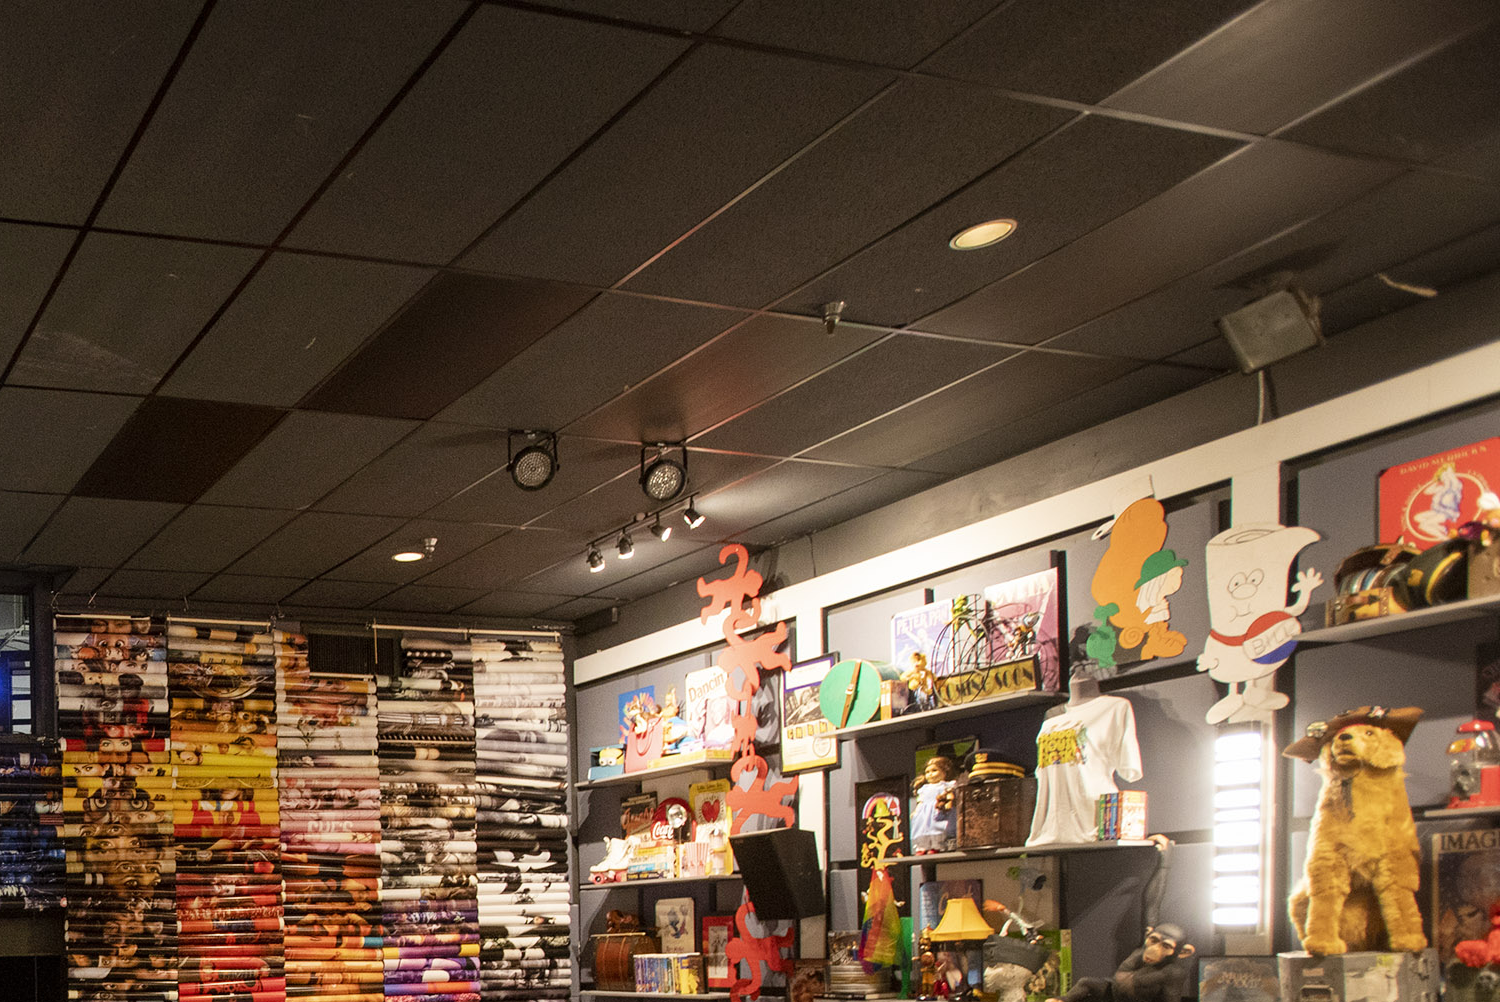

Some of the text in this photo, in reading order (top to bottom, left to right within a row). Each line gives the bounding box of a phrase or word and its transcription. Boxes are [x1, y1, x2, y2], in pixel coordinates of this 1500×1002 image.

[896, 612, 928, 635] PETER
[1252, 619, 1293, 656] BILL
[994, 666, 1034, 690] SOON
